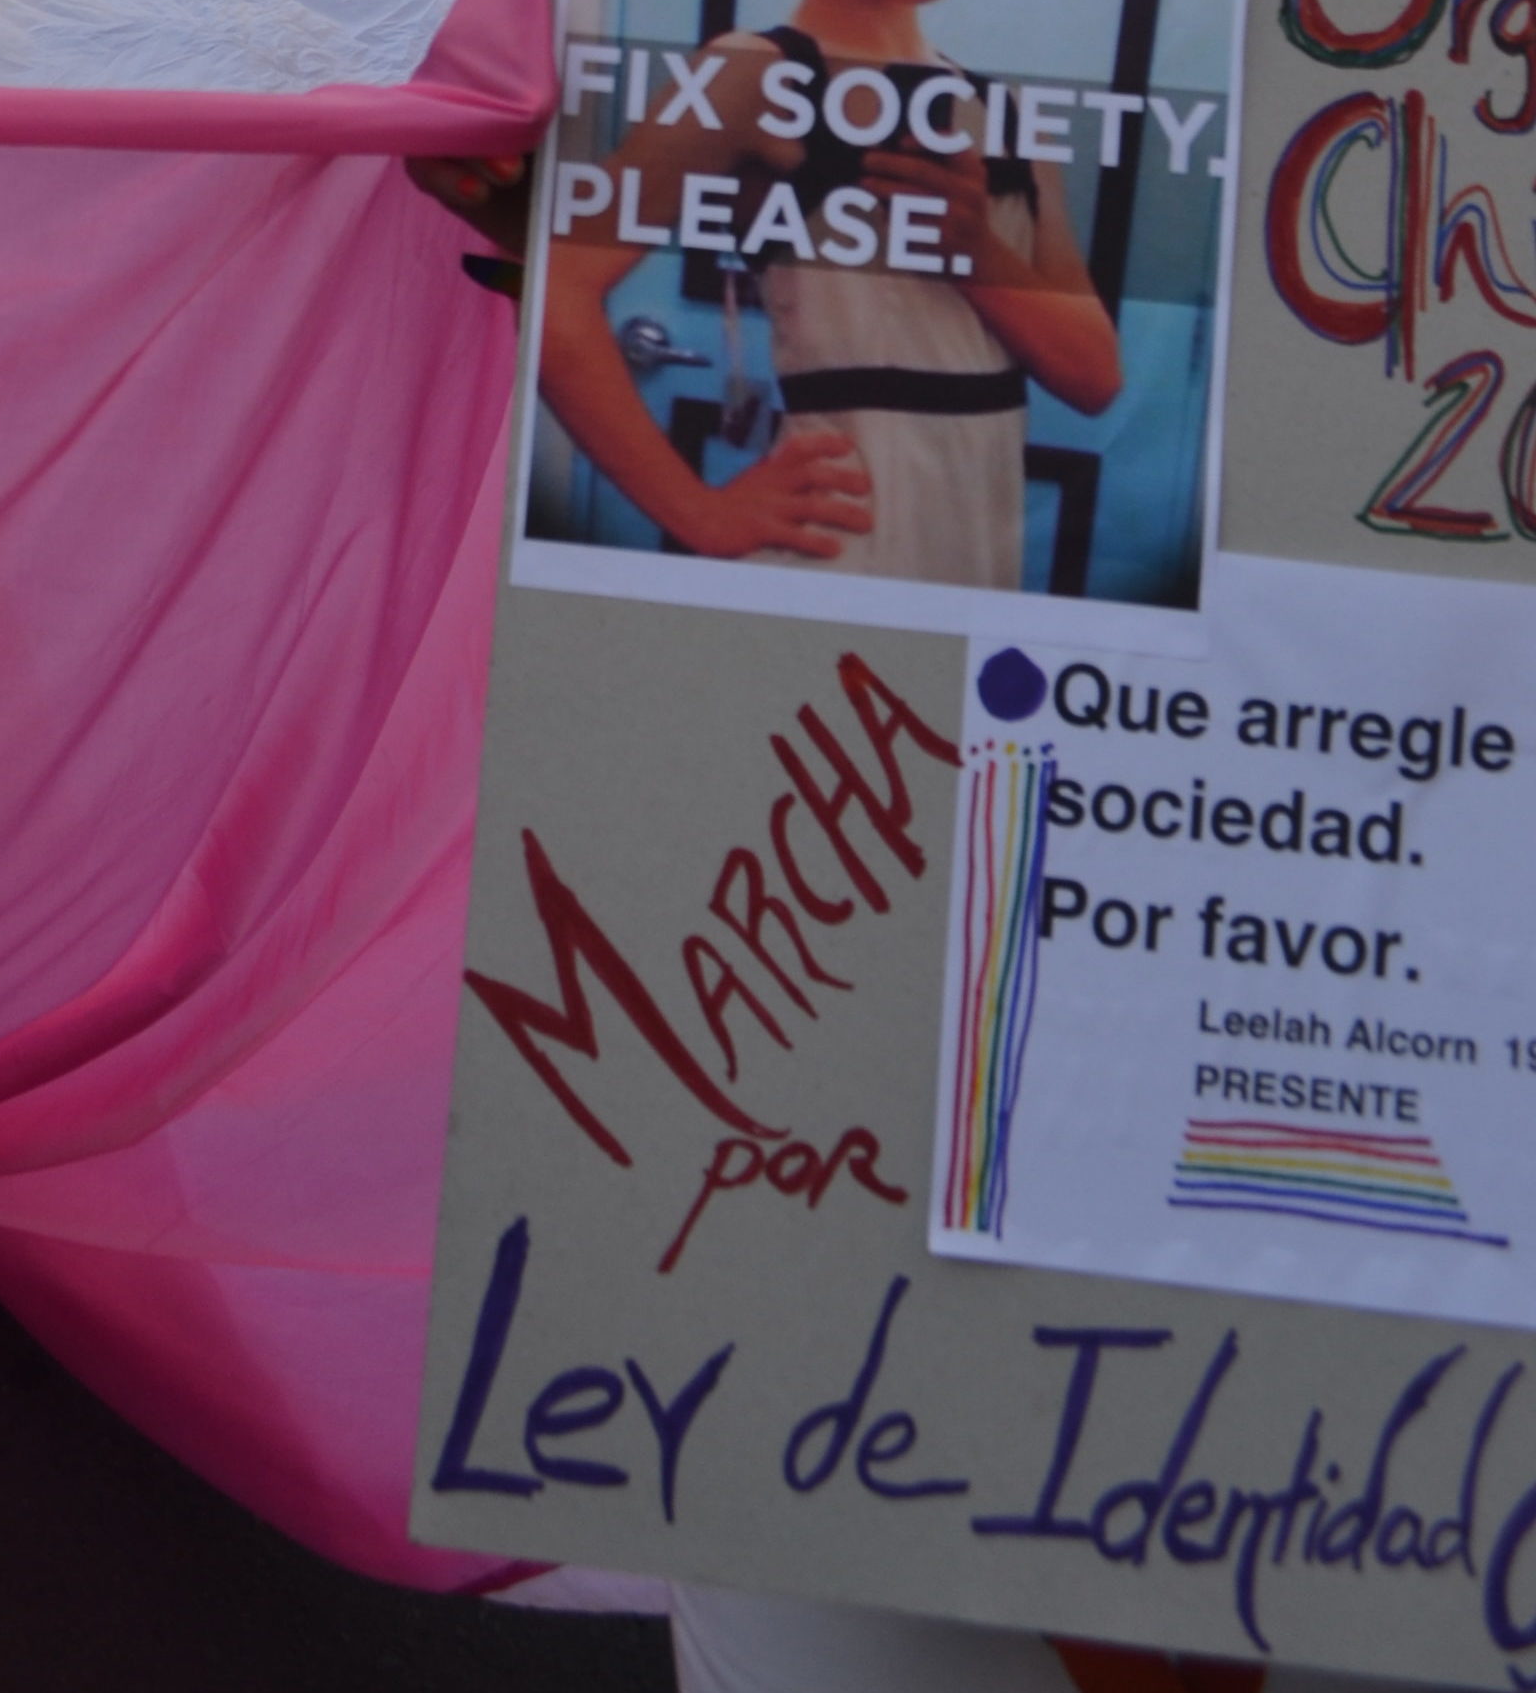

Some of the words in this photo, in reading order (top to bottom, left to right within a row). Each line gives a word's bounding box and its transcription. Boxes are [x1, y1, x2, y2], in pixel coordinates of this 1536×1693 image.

[563, 45, 725, 130] FIX
[757, 59, 1228, 180] SOCIETY.
[552, 162, 973, 278] PLEASE.
[1052, 662, 1210, 738] Que
[1237, 694, 1515, 782] arregle
[1043, 777, 1424, 867] sociedad.
[465, 651, 964, 1169] MARCHA
[1038, 876, 1174, 952] Por
[1197, 897, 1421, 982] favor.
[1198, 1000, 1332, 1047] Leelah
[1344, 1020, 1477, 1065] Alcorn
[1196, 1064, 1420, 1122] PRESENTE
[782, 1274, 969, 1498] de
[971, 1326, 1525, 1651] Identidad
